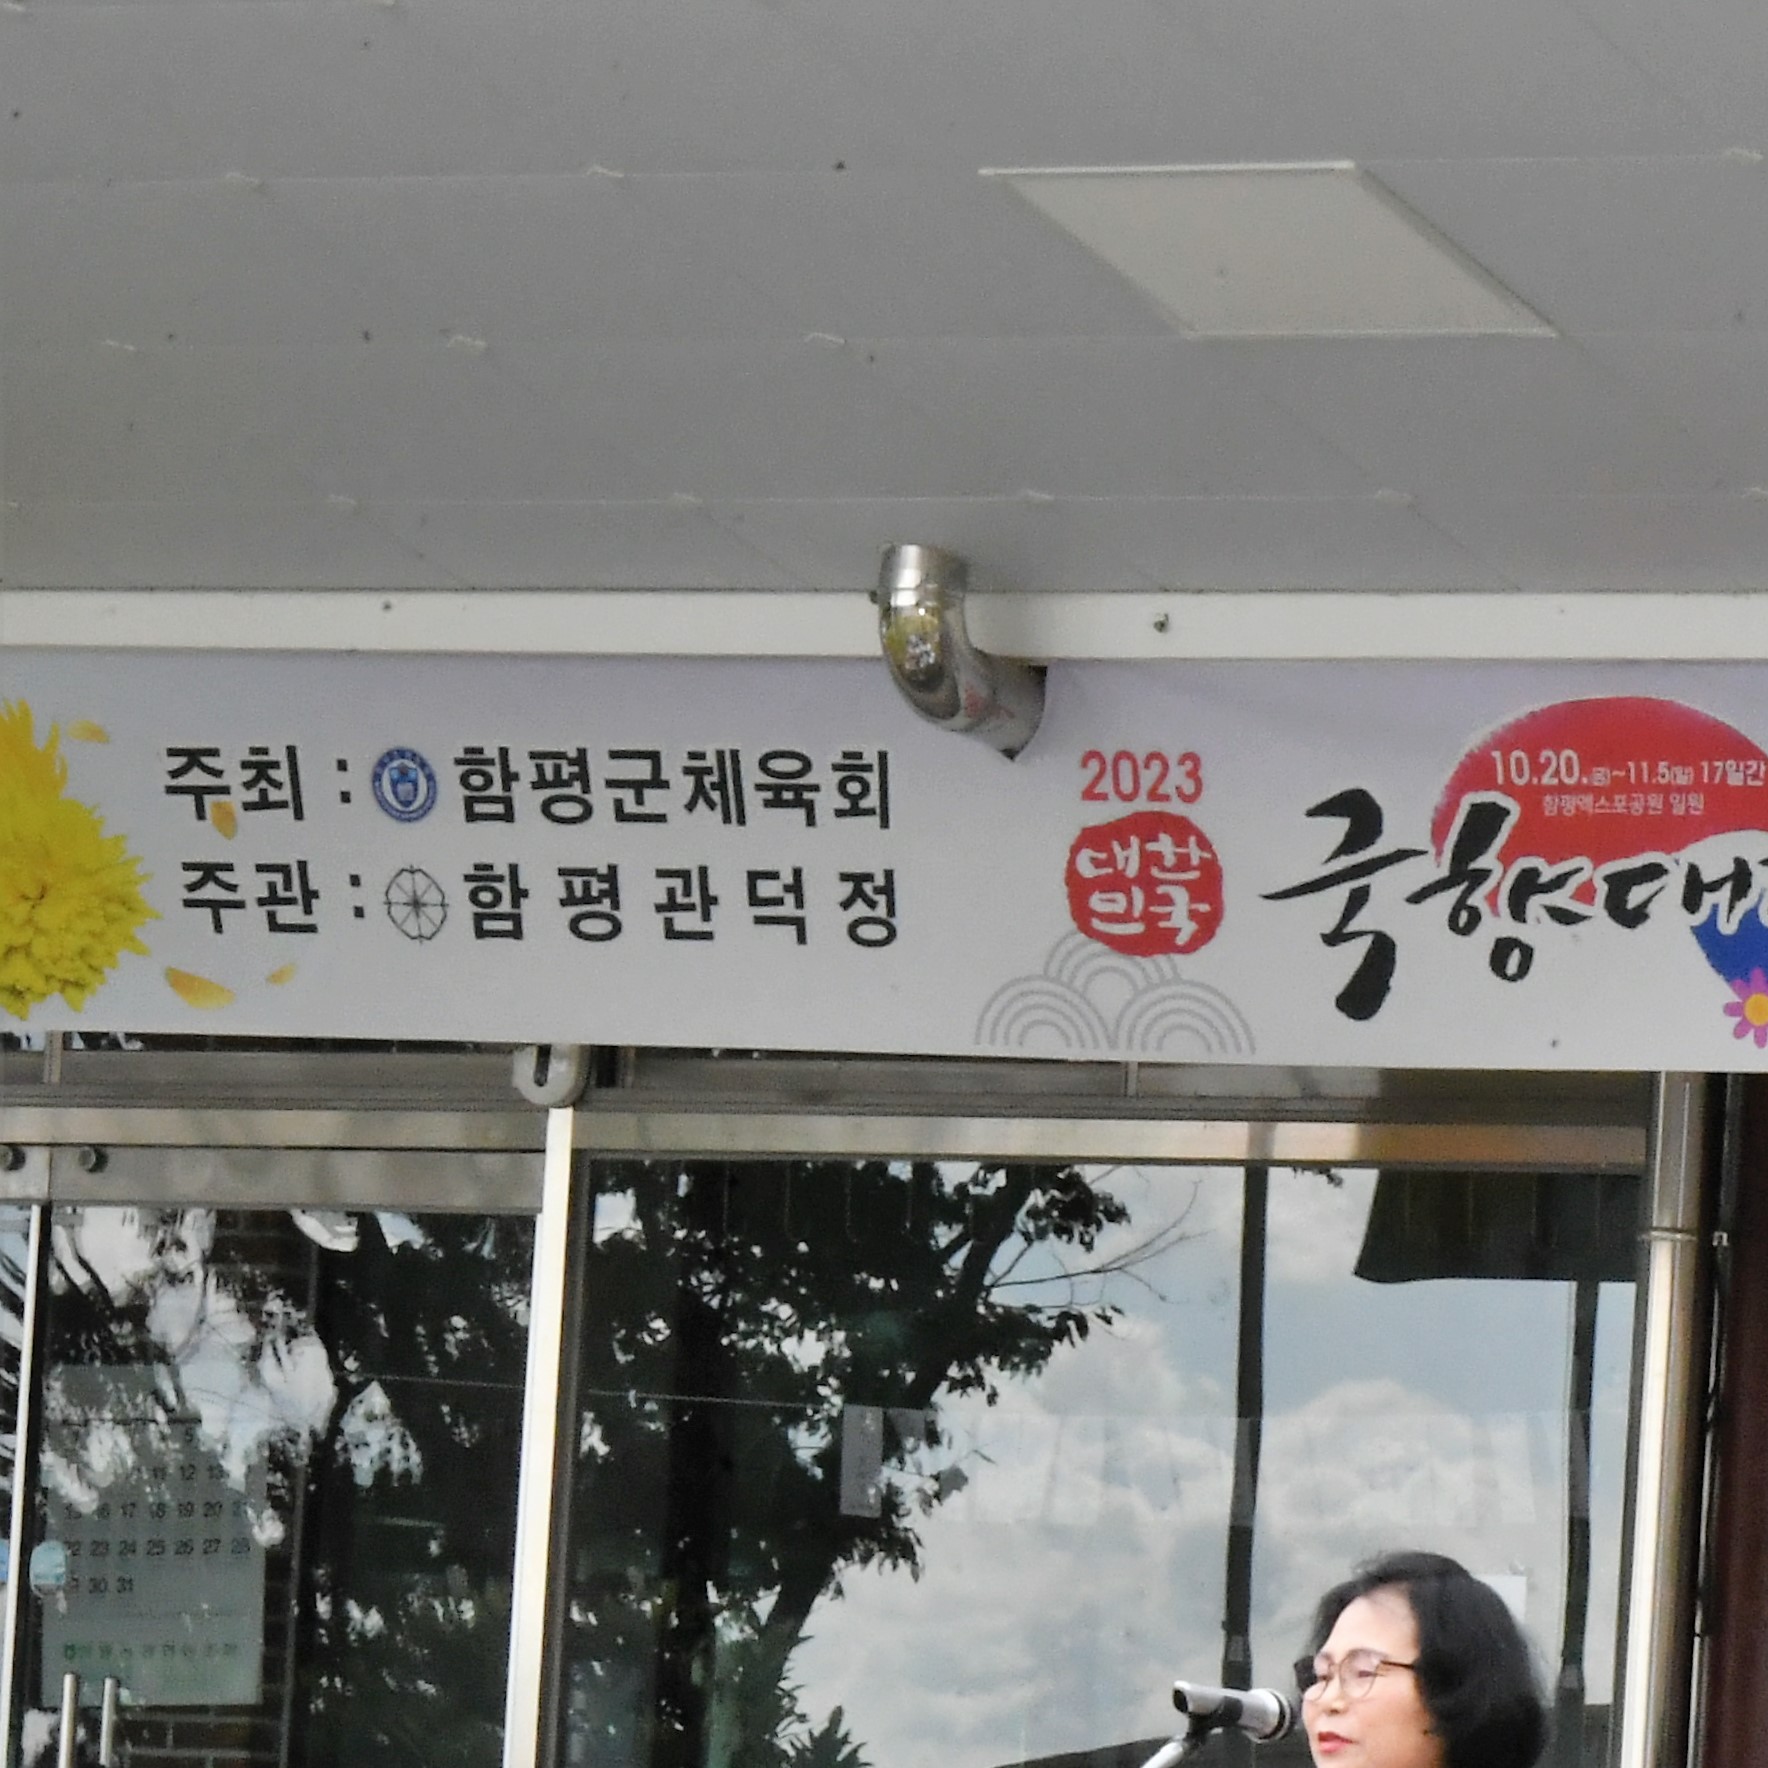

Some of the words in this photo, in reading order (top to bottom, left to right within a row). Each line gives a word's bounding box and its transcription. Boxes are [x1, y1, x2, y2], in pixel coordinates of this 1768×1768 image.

[163, 744, 305, 821] 주최
[453, 745, 893, 830] 함평군체육회
[1079, 749, 1204, 804] 2023
[1075, 832, 1213, 880] 대한
[180, 859, 321, 936] 주관
[1088, 884, 1212, 946] 민국
